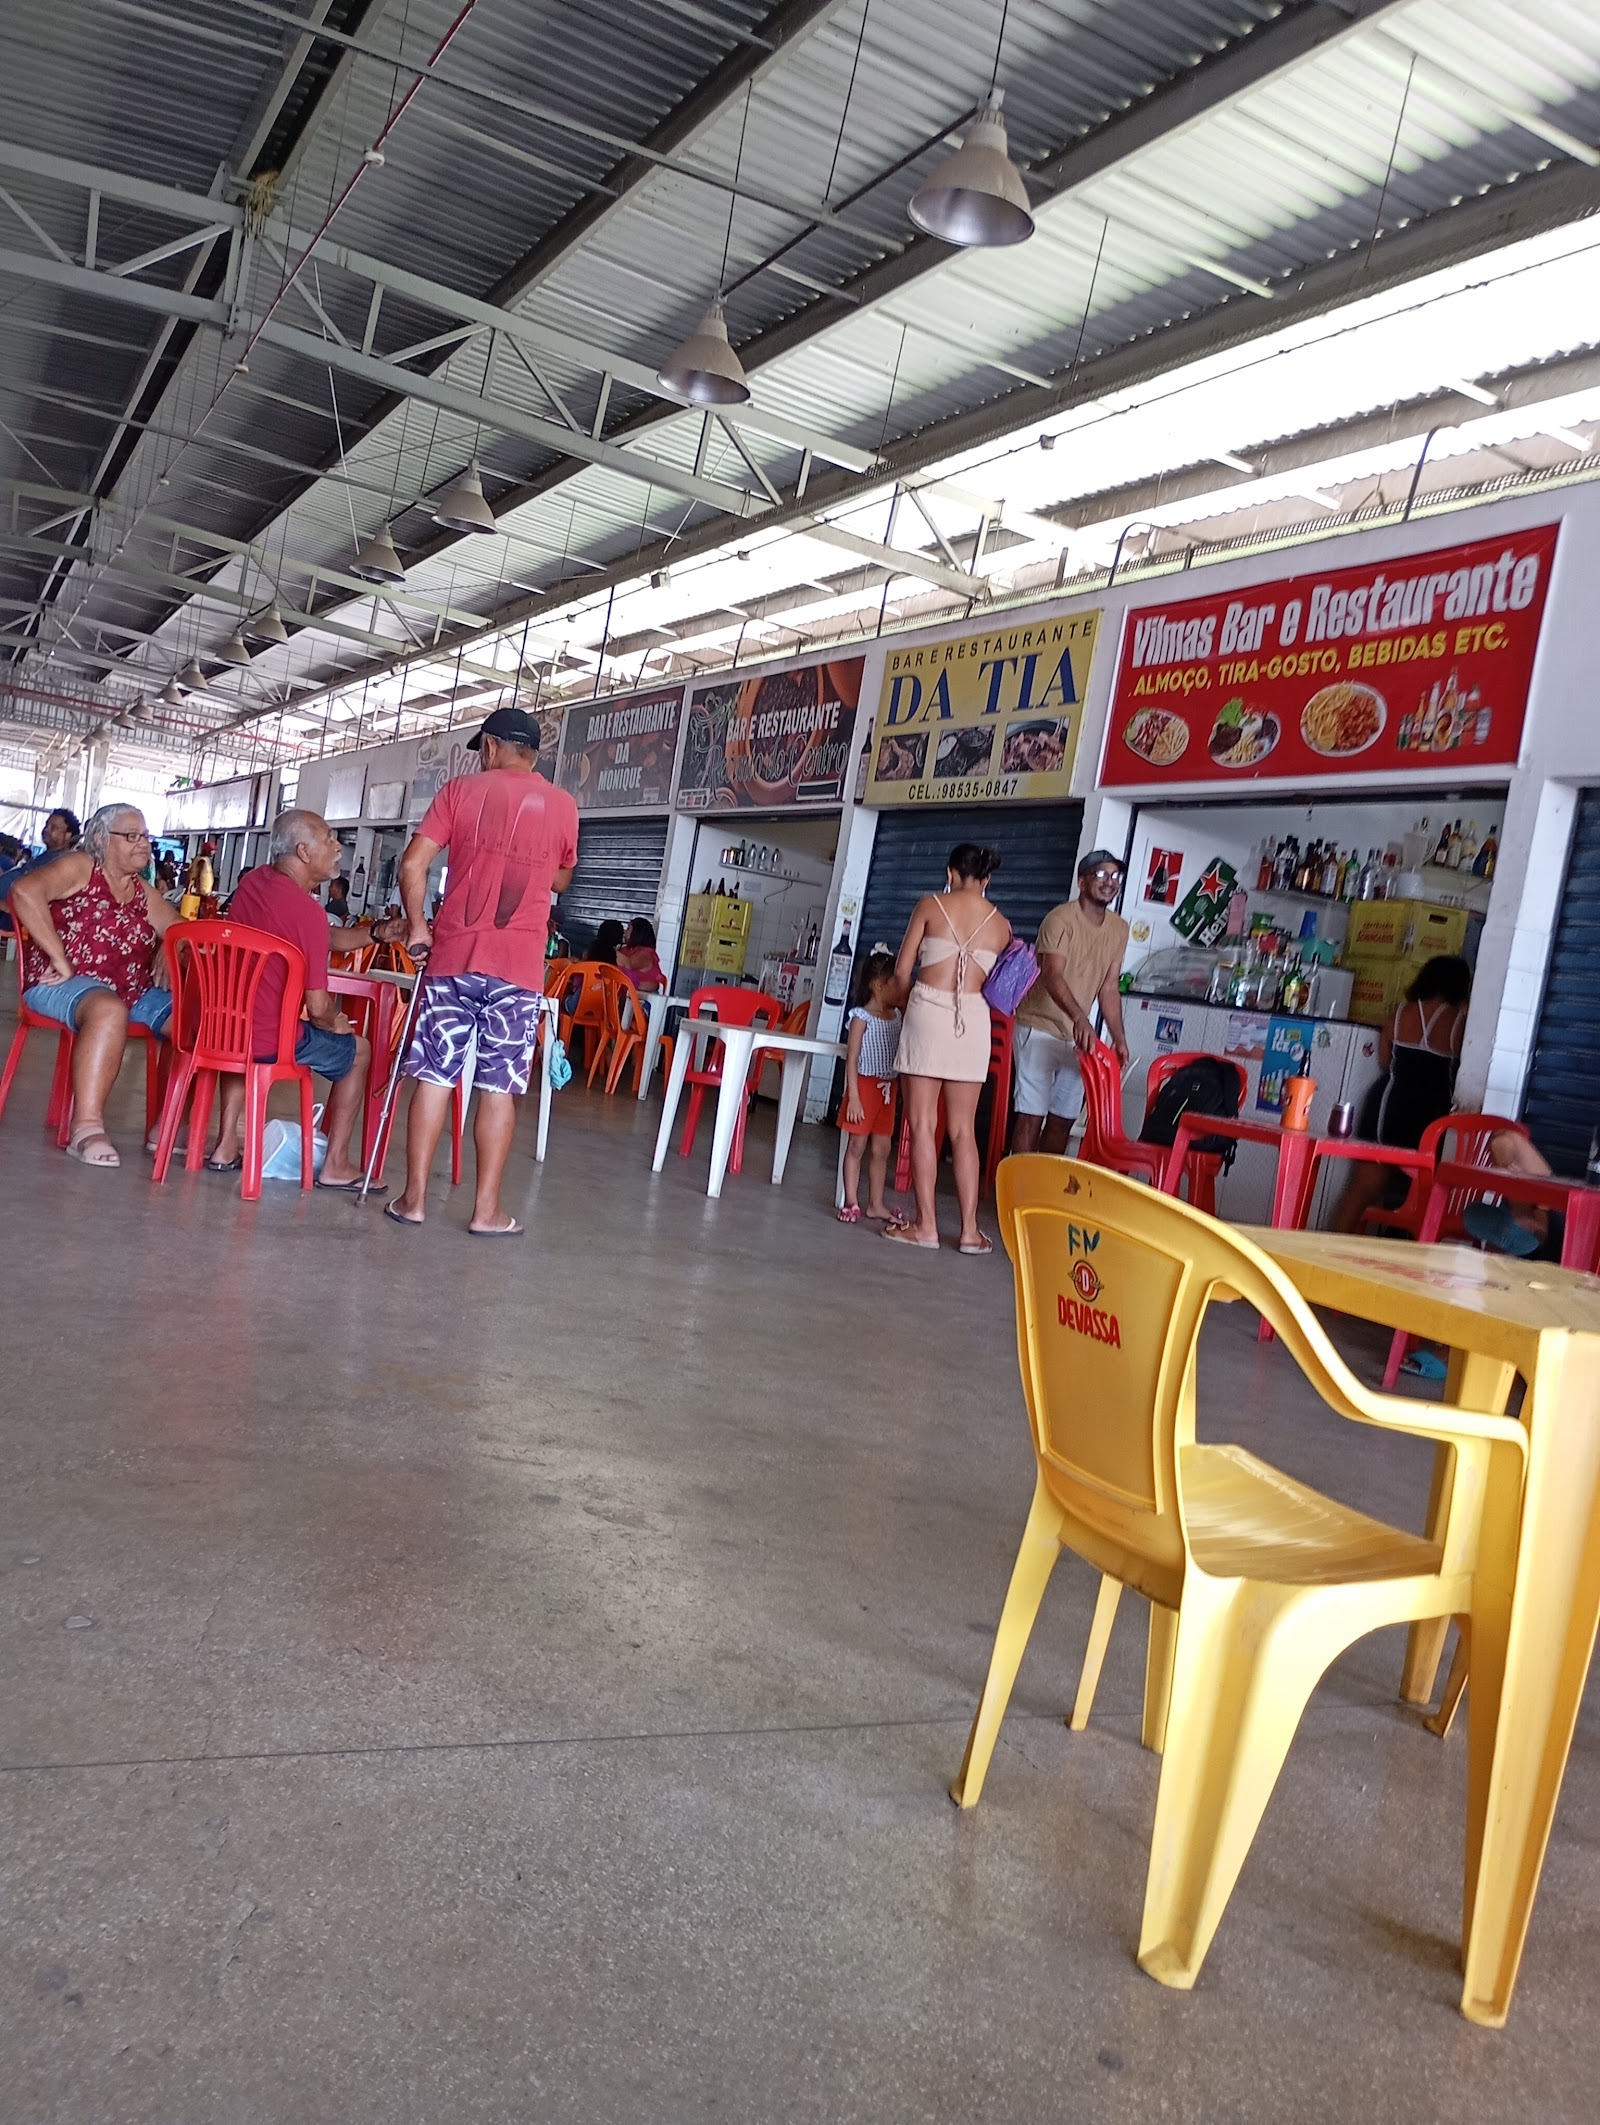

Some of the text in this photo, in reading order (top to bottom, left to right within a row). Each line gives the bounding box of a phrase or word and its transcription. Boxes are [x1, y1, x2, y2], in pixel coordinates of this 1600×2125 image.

[1132, 548, 1540, 668] Vilmas Bar e Restaurante
[892, 619, 1094, 671] BAR E RESTAURANTE
[1133, 666, 1212, 697] ALMOÇO,
[1218, 647, 1341, 687] TIRA-GOSTO,
[1347, 630, 1448, 670] BEBIDAS
[884, 646, 1081, 727] DA TIA
[586, 700, 677, 742] BAR E RESTAURANTE
[726, 701, 842, 741] BAR E RESTAURANTE
[597, 766, 643, 792] MONIQUE
[614, 741, 630, 765] DA
[1057, 1293, 1121, 1350] DEVASSA
